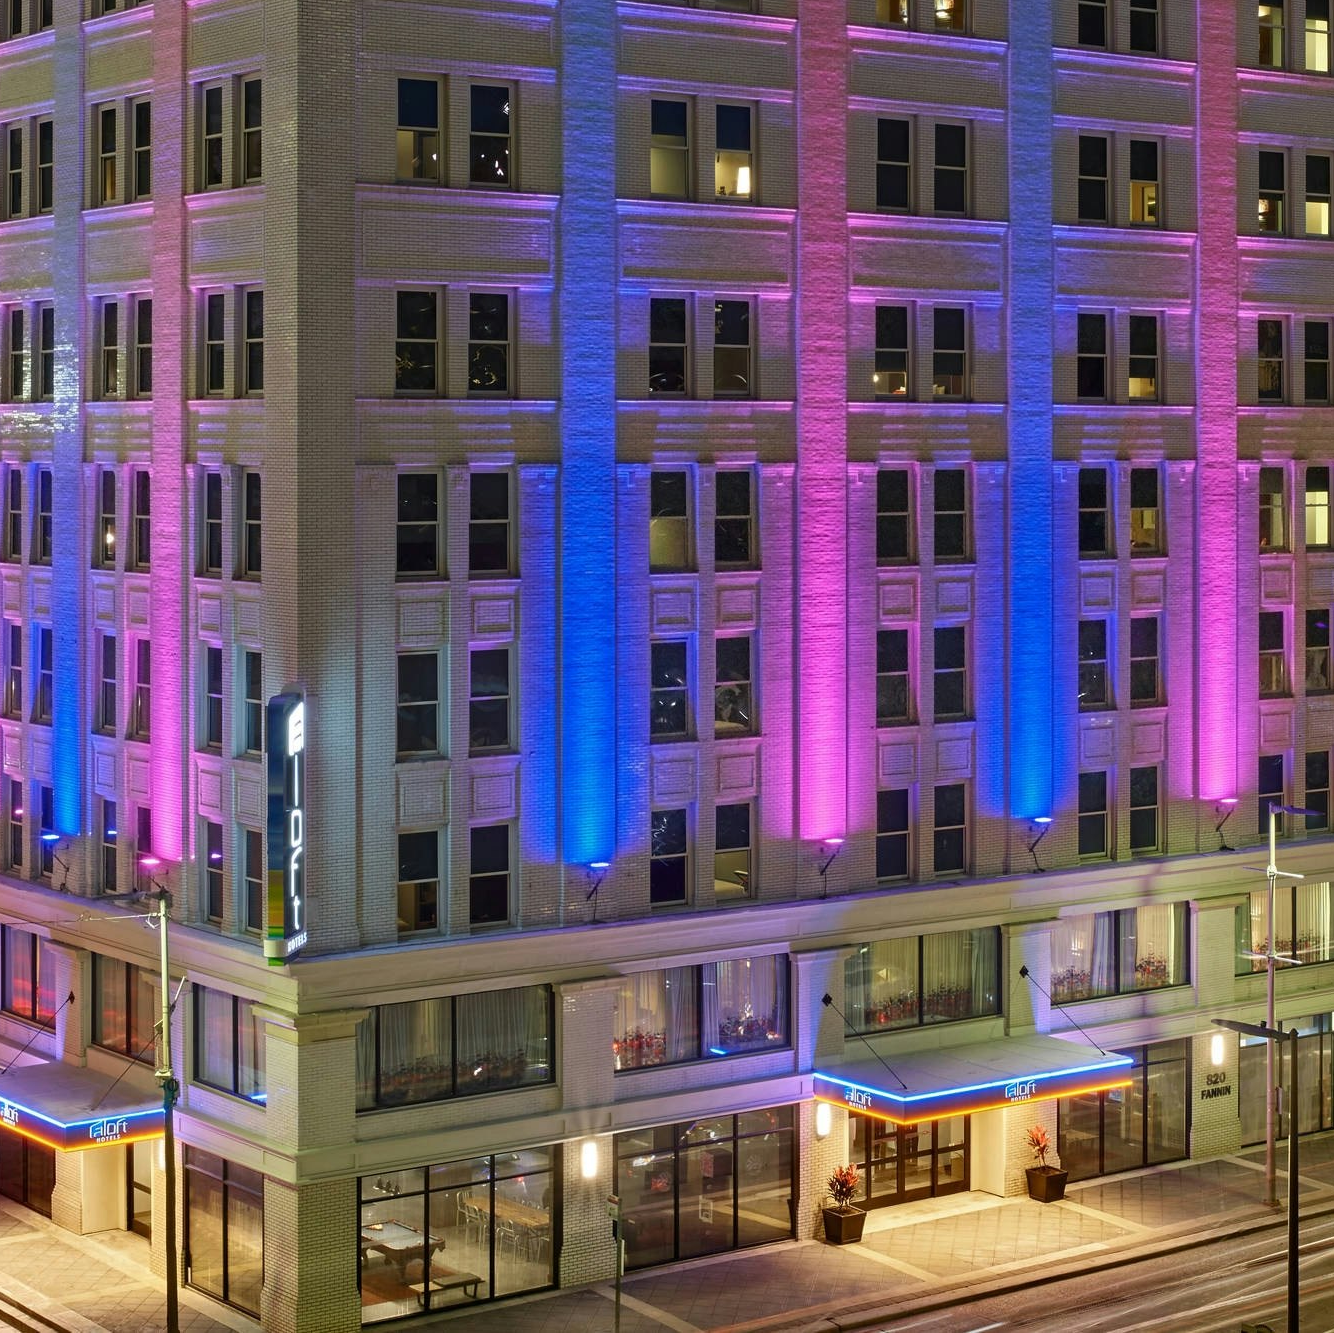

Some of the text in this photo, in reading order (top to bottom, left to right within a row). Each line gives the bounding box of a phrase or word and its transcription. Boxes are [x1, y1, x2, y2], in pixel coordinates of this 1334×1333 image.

[287, 701, 306, 930] aloft
[287, 931, 308, 953] HOTELS
[1206, 1071, 1226, 1085] 820
[1005, 1080, 1036, 1098] aloft
[1201, 1085, 1231, 1100] FANNIN
[89, 1117, 128, 1138] aloft
[96, 1134, 121, 1143] HOTELS
